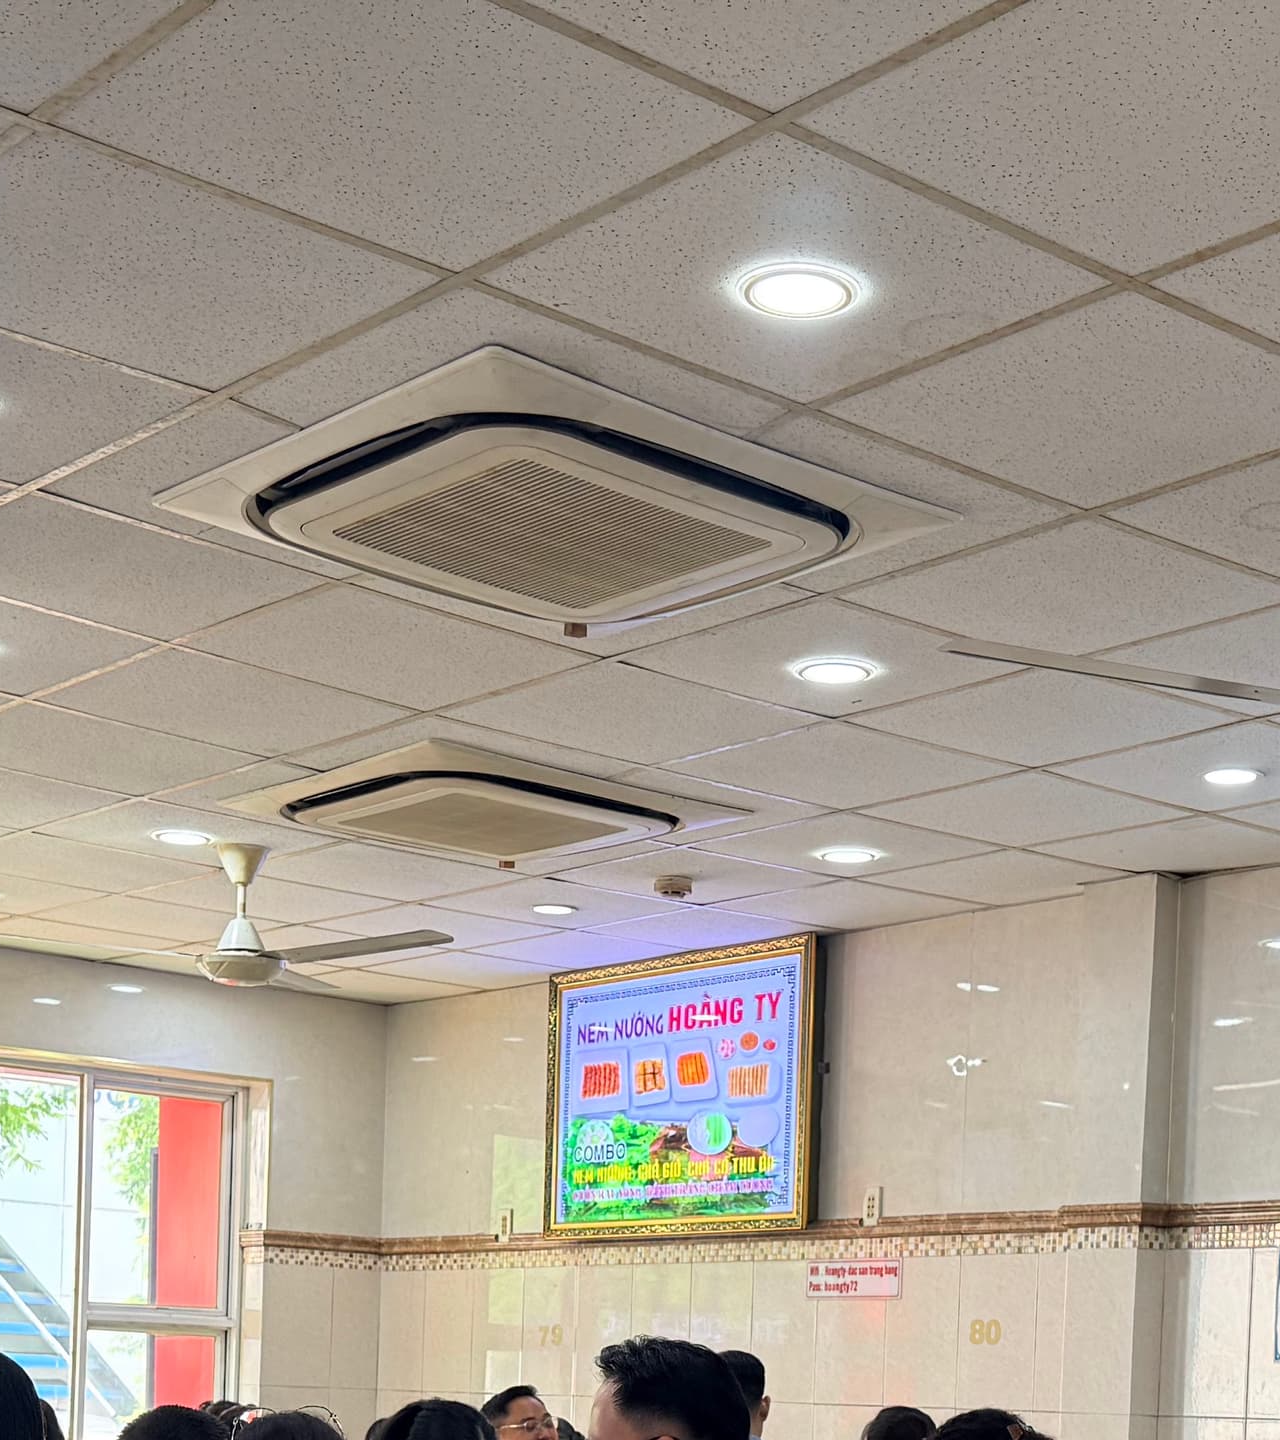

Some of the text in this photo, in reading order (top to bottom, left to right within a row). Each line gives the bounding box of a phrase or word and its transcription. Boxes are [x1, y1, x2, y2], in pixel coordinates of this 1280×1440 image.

[577, 1021, 609, 1045] NEM
[667, 991, 744, 1032] HOÀNG
[755, 991, 782, 1021] TY
[574, 1143, 626, 1163] COMBO
[824, 1280, 858, 1293] hoangty72
[969, 1319, 1002, 1345] 80
